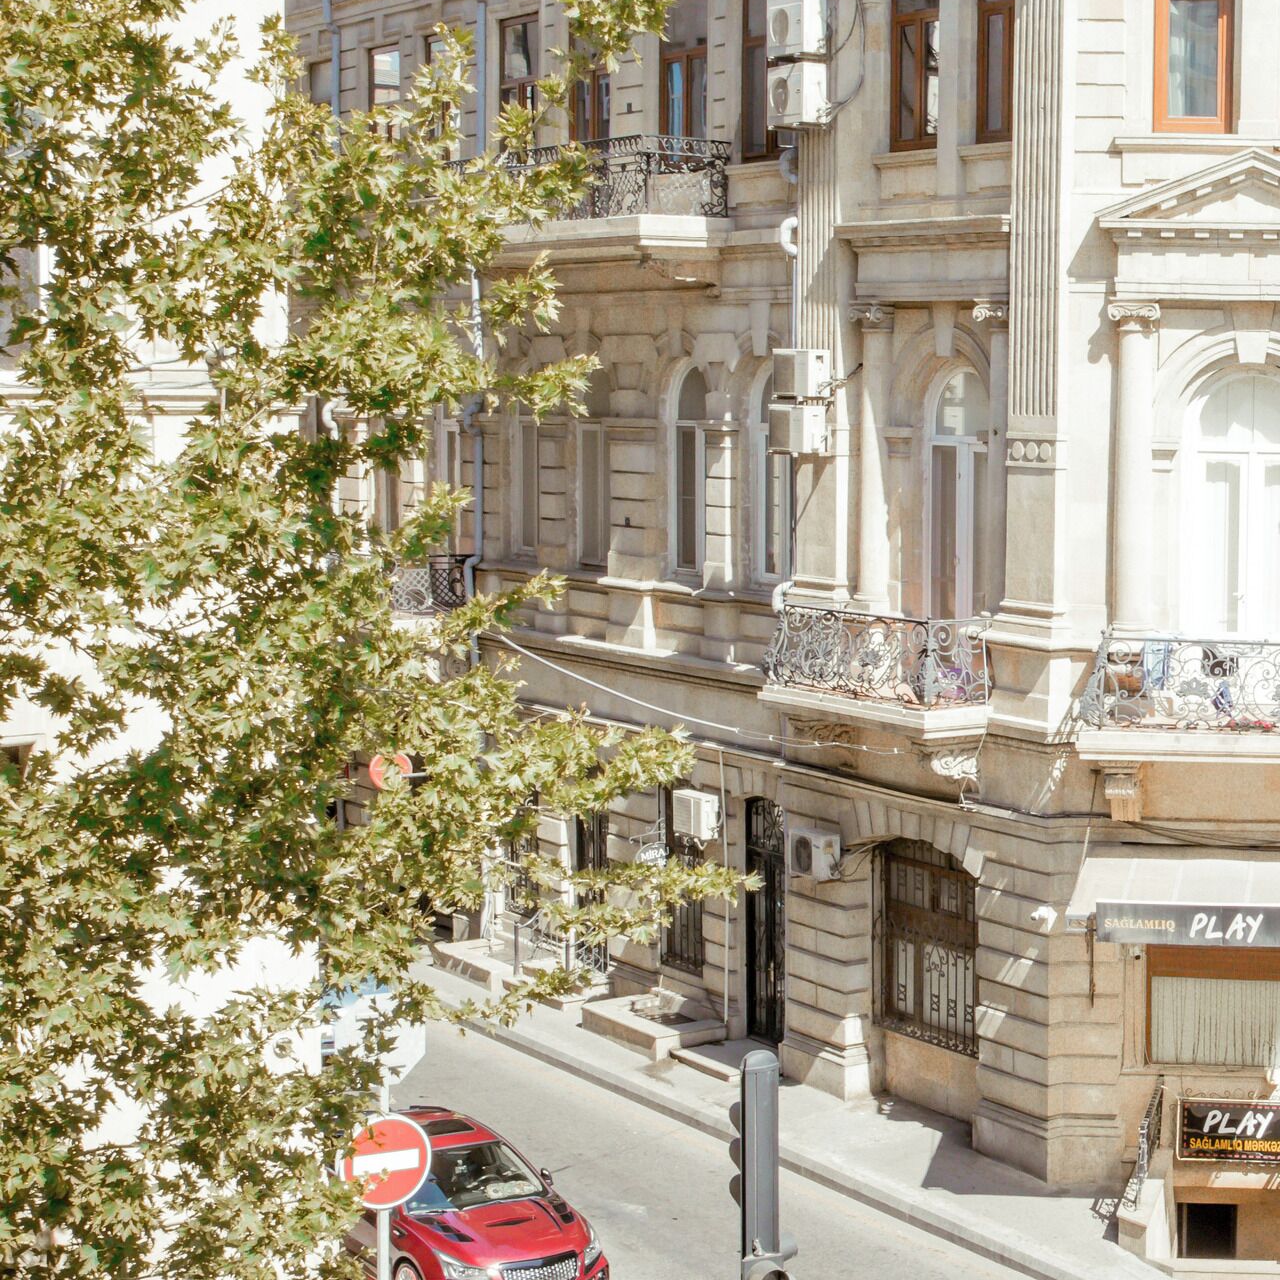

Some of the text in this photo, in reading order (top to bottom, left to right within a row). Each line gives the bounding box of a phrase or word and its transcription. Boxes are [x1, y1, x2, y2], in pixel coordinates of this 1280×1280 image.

[1104, 917, 1176, 933] SAĞLAMLIQ
[1189, 912, 1264, 944] PLAY
[1202, 1109, 1275, 1139] PLAY
[1189, 1136, 1243, 1151] SAĞLAMLIQ
